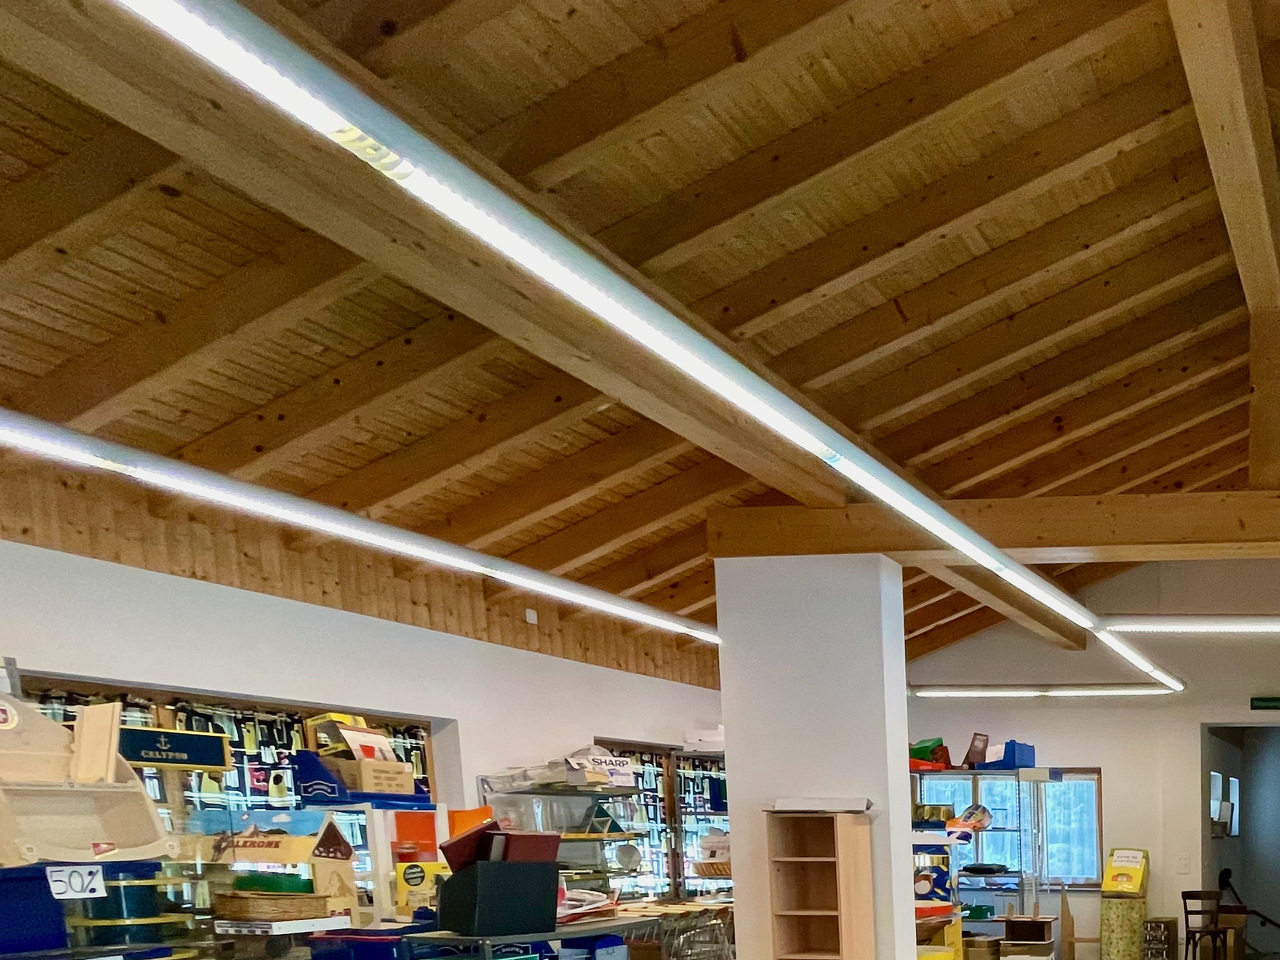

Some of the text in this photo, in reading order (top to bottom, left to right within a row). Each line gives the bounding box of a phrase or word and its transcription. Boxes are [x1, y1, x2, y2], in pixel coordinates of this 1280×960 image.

[141, 750, 188, 760] CALYPSO
[591, 757, 629, 768] SHARP
[50, 869, 99, 895] 50%
